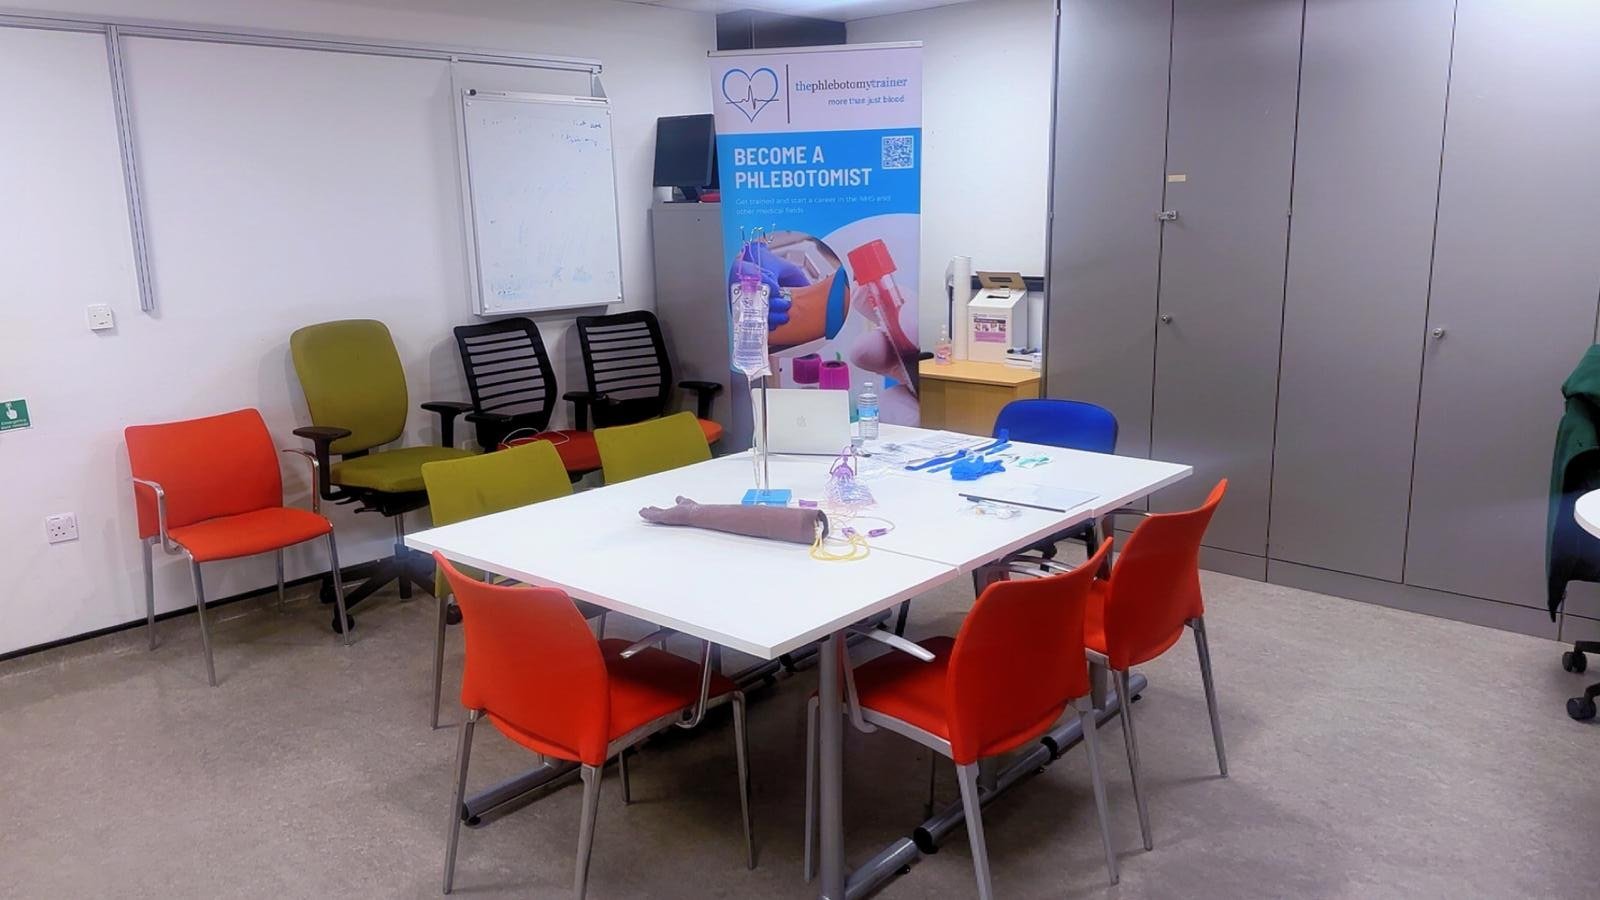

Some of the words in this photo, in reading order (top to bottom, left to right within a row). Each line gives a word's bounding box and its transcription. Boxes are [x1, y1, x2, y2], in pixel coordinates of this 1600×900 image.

[795, 77, 908, 93] thephlebotomytrainer
[828, 98, 848, 106] more
[849, 97, 866, 105] than
[866, 96, 882, 106] just
[883, 95, 905, 104] blood
[734, 146, 807, 166] BECOME
[812, 146, 825, 164] A
[735, 168, 872, 189] PHLEBOTOMIST
